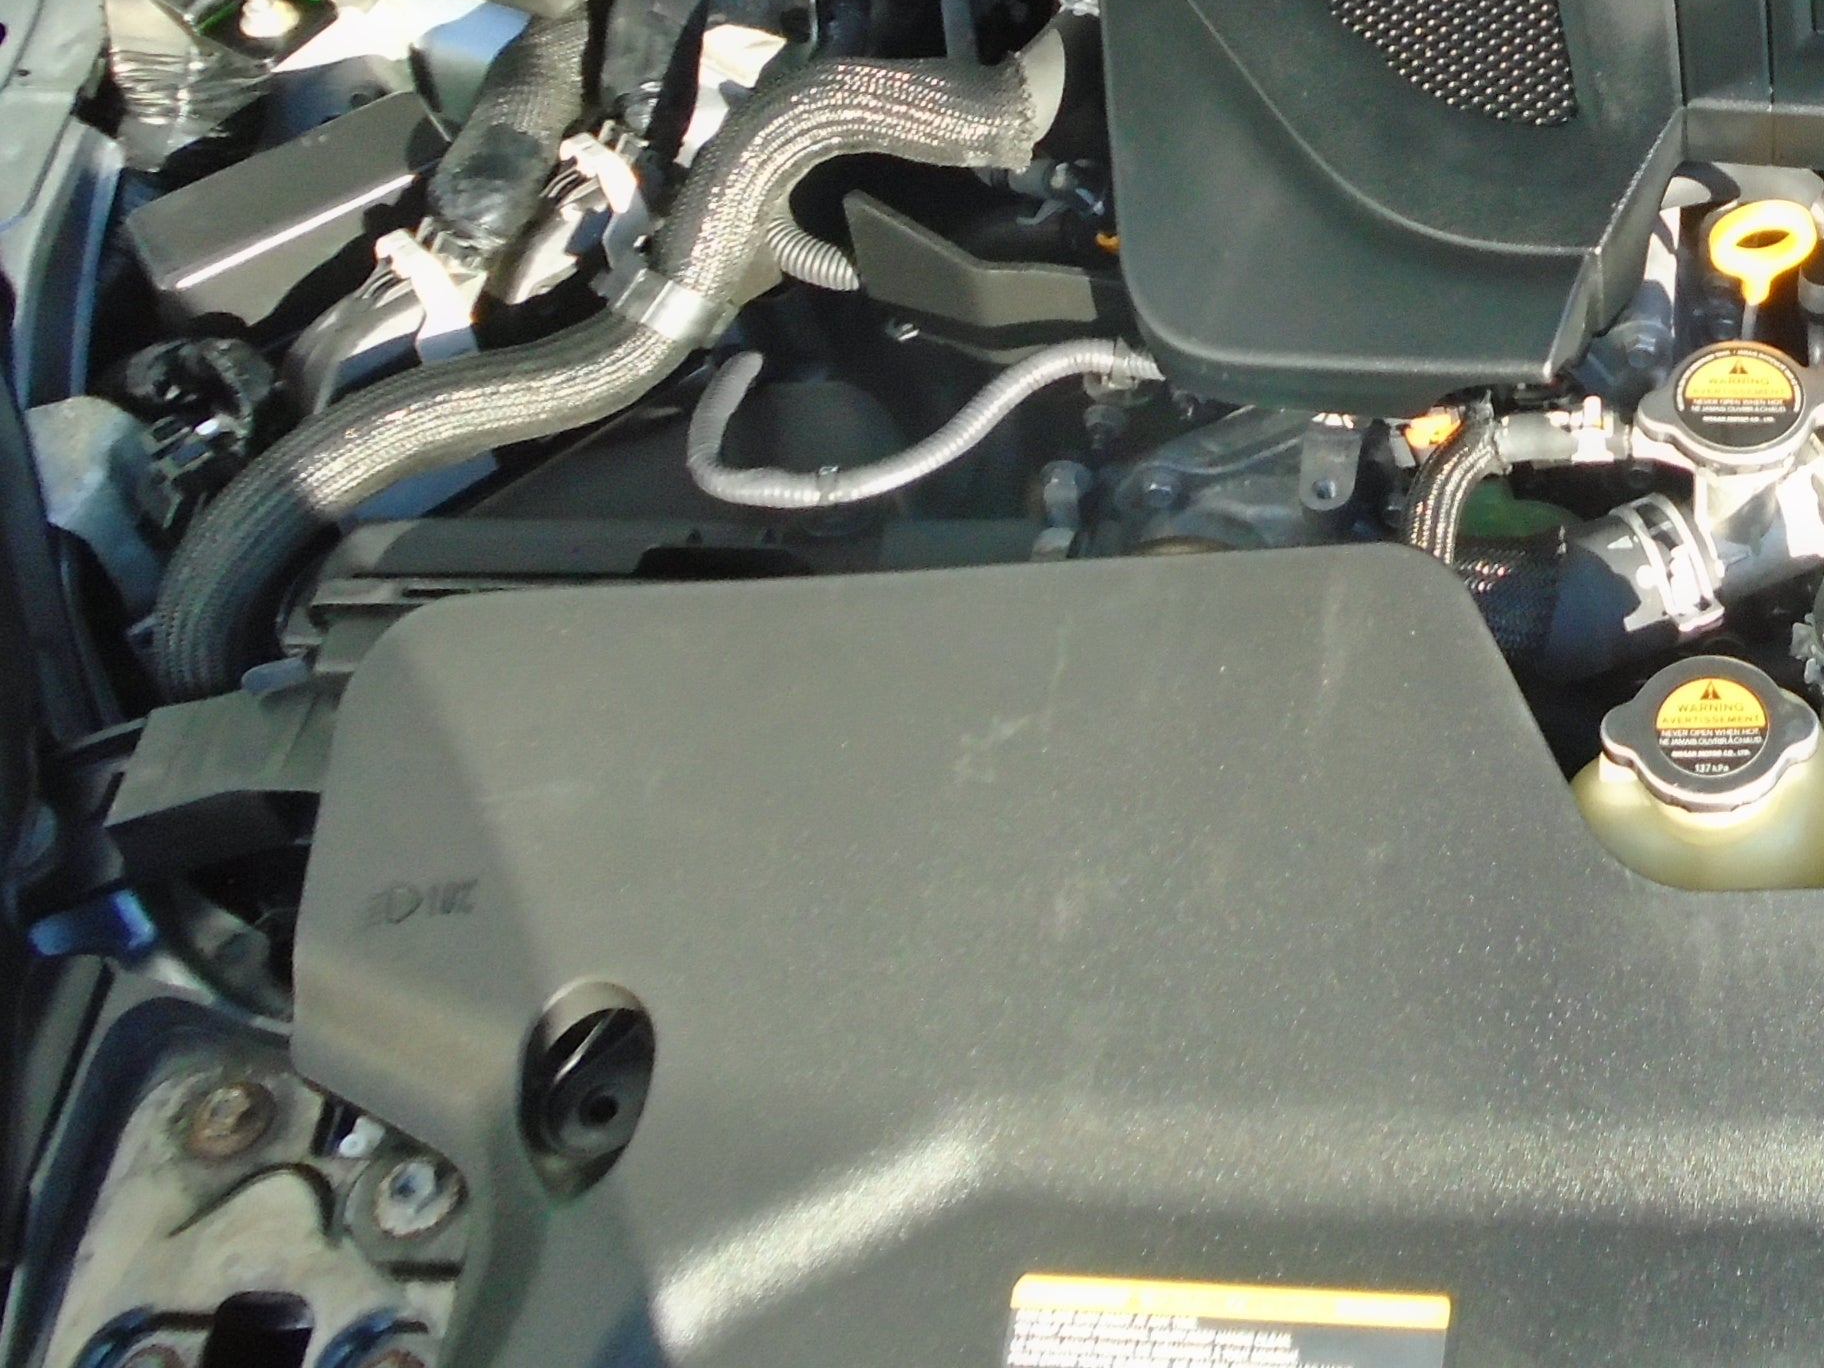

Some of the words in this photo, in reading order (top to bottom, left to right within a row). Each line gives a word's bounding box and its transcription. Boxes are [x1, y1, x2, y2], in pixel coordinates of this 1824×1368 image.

[1677, 703, 1745, 713] WARNING
[1662, 714, 1760, 725] AVERTISSEMENT
[1661, 729, 1689, 737] NEVER
[1690, 729, 1714, 737] OPEN
[1715, 728, 1740, 736] WHEN
[1695, 763, 1711, 772] 137
